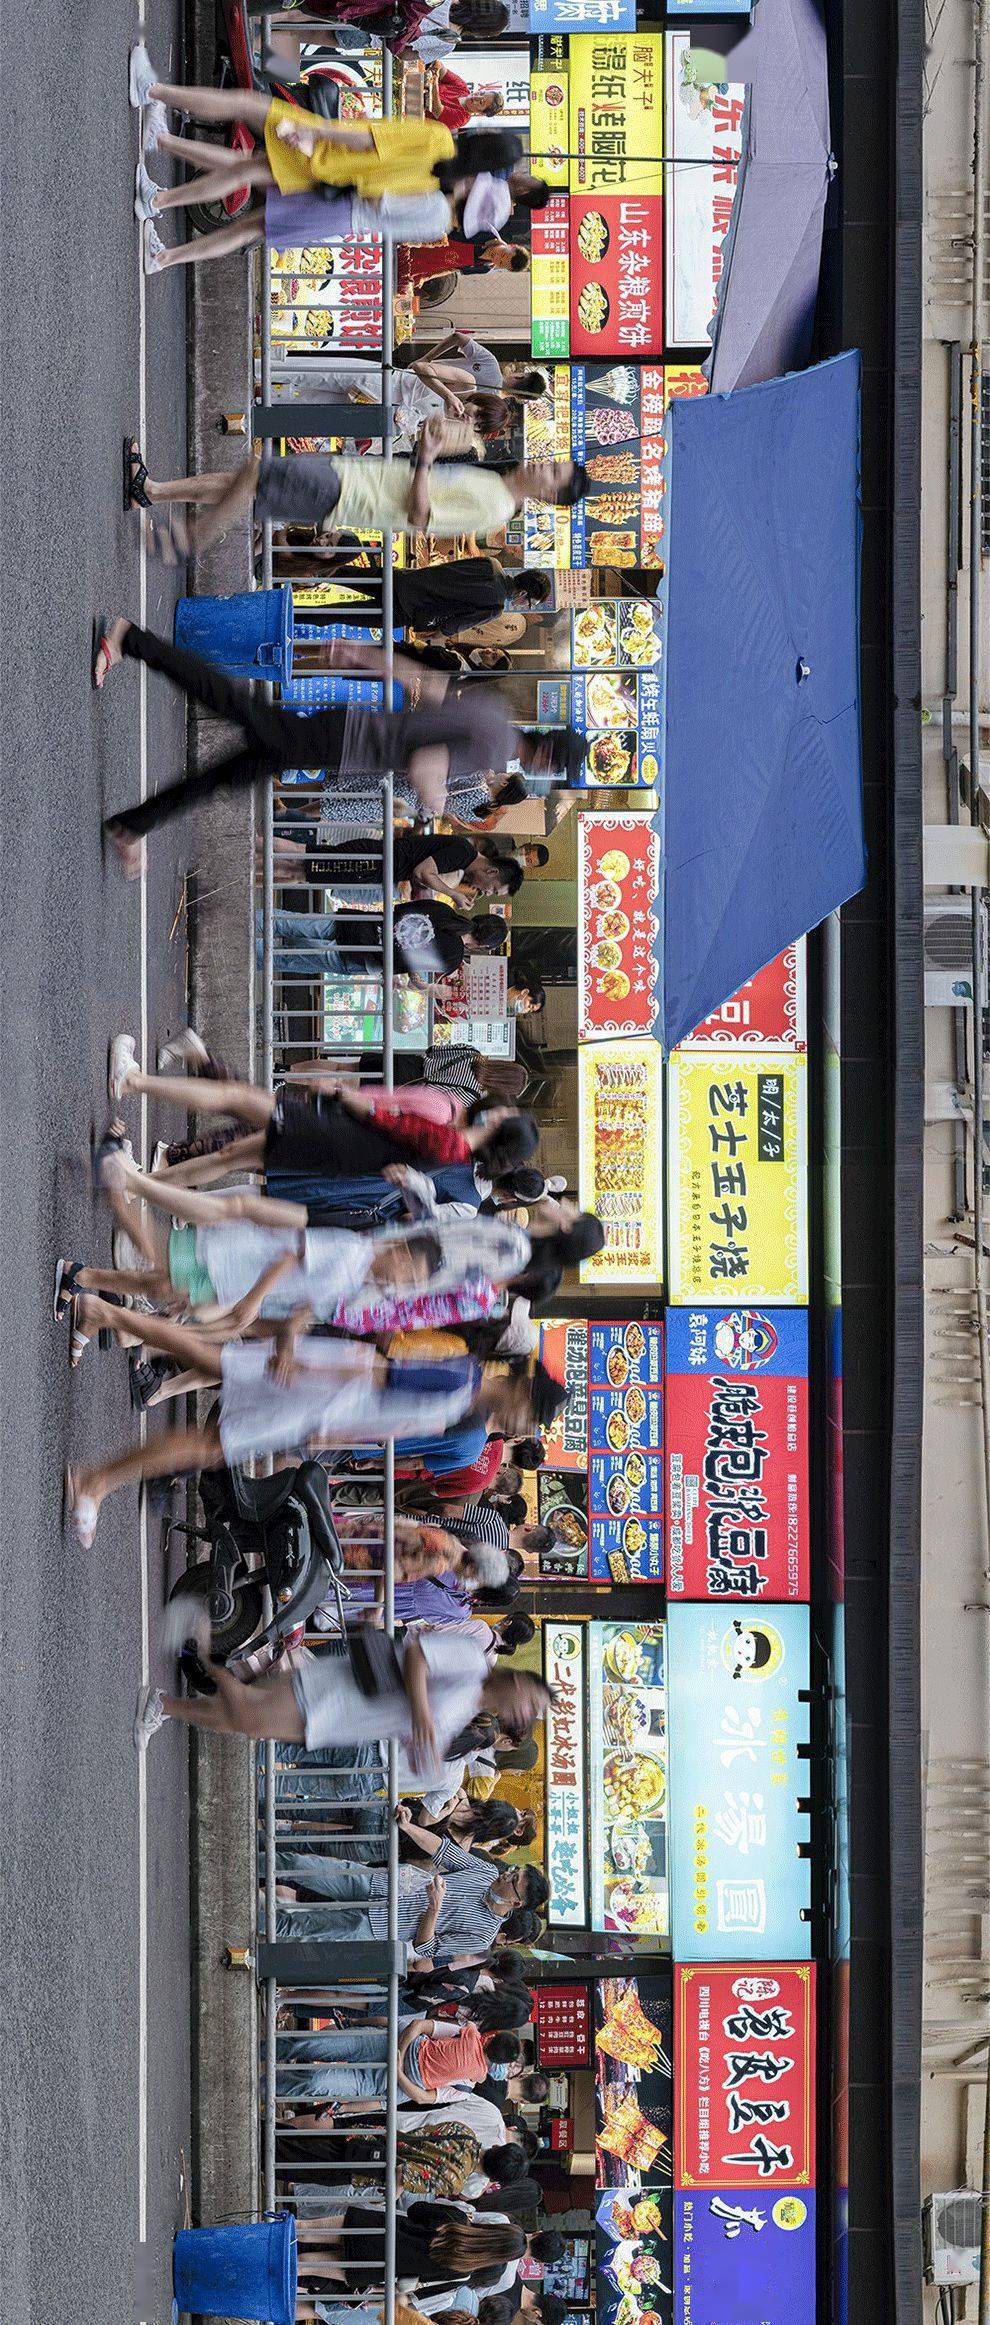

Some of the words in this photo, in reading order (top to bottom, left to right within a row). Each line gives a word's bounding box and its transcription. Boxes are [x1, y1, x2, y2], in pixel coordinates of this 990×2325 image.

[591, 46, 626, 184] 锡纸烤脑花
[617, 203, 652, 348] 山东杂粮煎饼
[709, 1081, 749, 1280] 芝士玉子烧
[689, 1313, 708, 1367] 袁阿妹
[705, 1377, 770, 1596] 脆皮包浆豆腐
[566, 1791, 577, 1834] 小姐姐
[559, 2121, 568, 2148] 取餐区
[721, 2005, 794, 2176] 苕皮豆干
